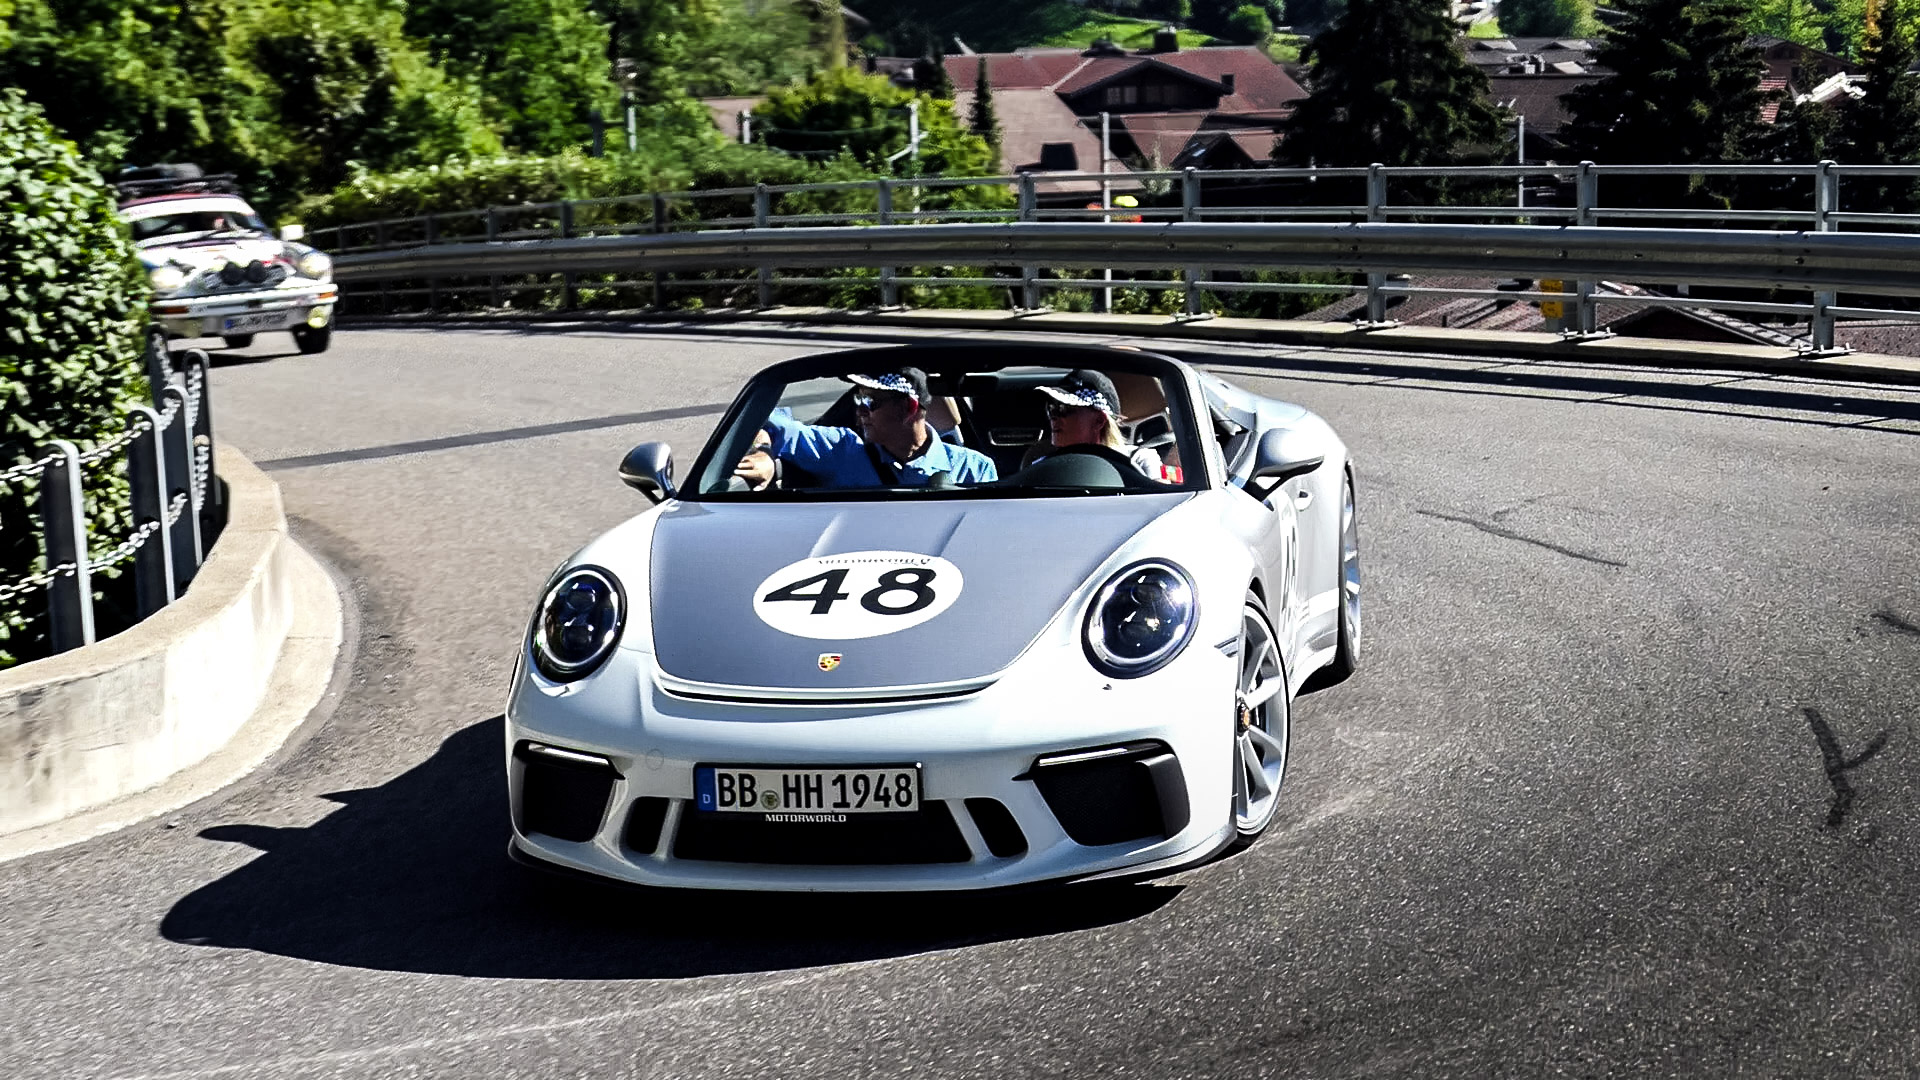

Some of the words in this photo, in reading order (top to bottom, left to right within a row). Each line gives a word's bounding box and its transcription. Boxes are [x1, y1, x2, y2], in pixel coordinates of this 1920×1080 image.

[762, 568, 937, 616] 48
[702, 794, 711, 804] D
[717, 773, 758, 808] BB
[782, 773, 824, 809] HH
[831, 773, 913, 809] 1948
[765, 813, 847, 823] MOTORWORLD
